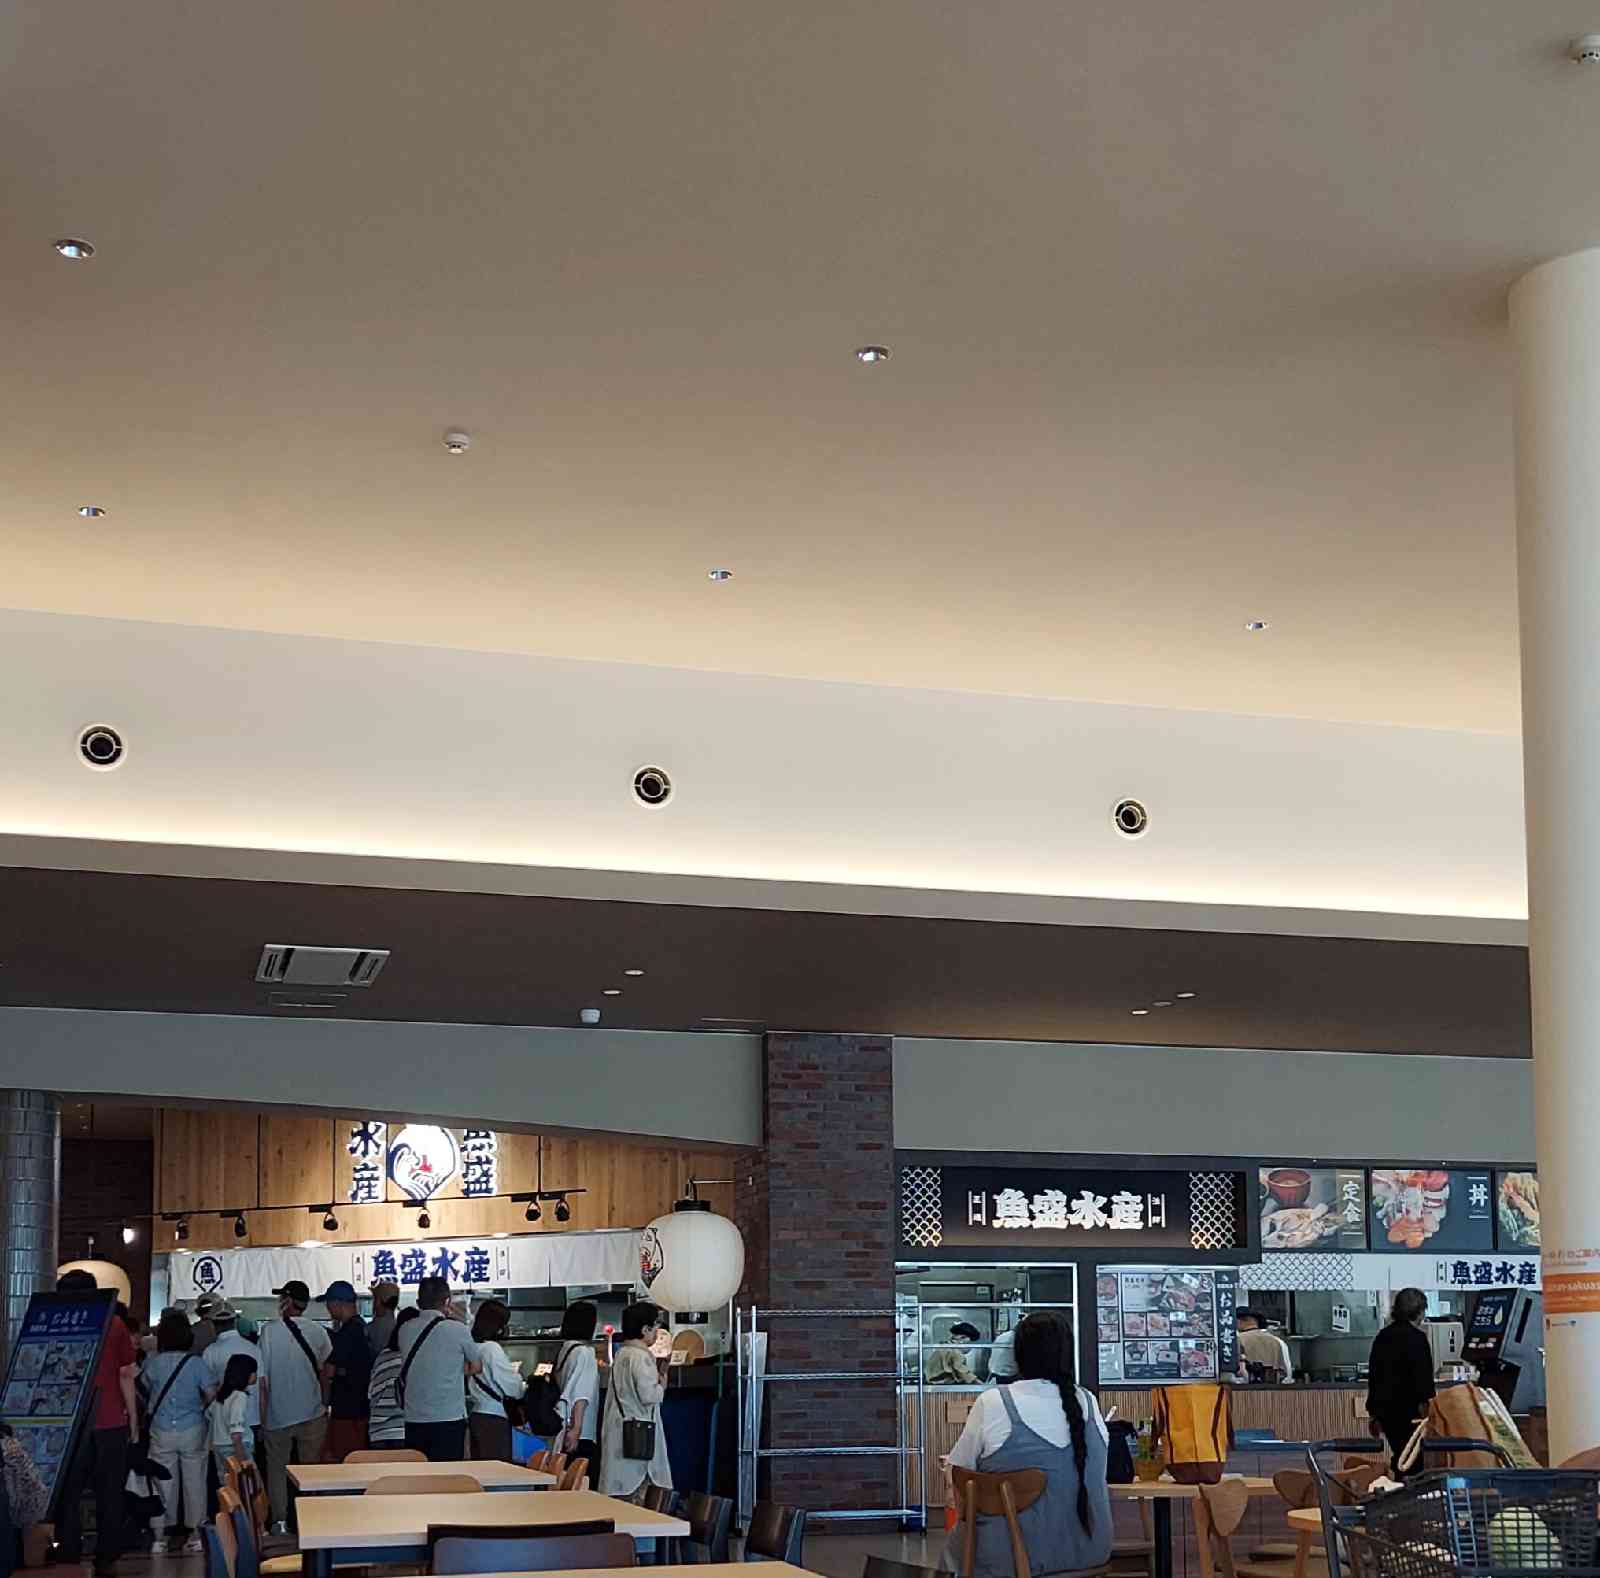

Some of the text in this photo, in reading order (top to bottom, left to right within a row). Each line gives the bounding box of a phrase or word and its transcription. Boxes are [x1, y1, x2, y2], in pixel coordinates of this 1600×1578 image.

[349, 1121, 380, 1203] 水産
[992, 1188, 1144, 1229] 魚盛水産
[1468, 1183, 1488, 1207] 丼
[371, 1247, 490, 1287] 魚盛水産
[1450, 1260, 1537, 1285] 魚盛水産
[1219, 1292, 1235, 1362] お品書き
